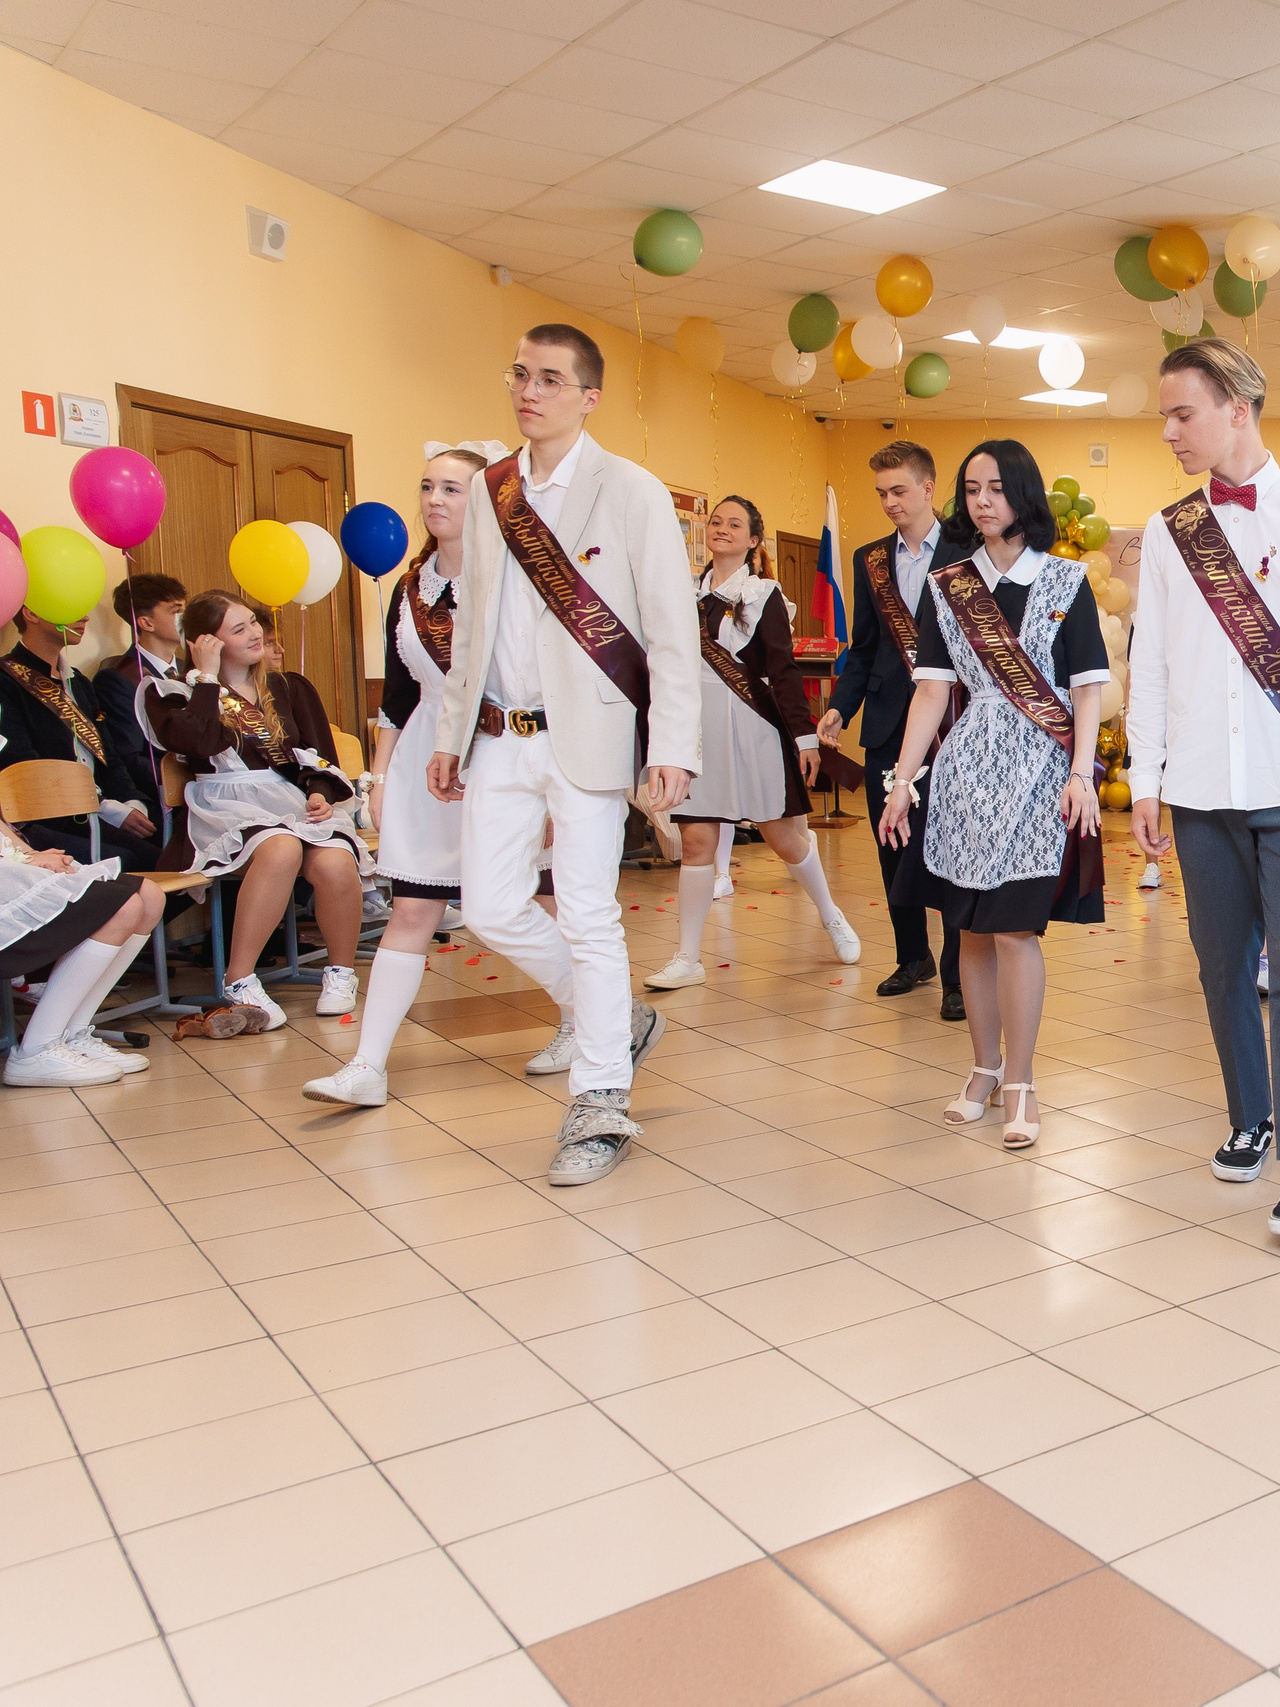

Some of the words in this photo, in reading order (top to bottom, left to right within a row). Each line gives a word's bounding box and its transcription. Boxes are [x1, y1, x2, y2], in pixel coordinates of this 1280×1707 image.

[505, 496, 581, 610] Выпускник
[569, 598, 625, 648] 2024
[873, 565, 917, 648] Выпускник
[1192, 529, 1271, 655] Выпускник
[1248, 596, 1274, 632] Максим
[966, 598, 1039, 702] Выпускница
[1219, 610, 1234, 633] Школа
[1248, 658, 1275, 697] Кронштадт
[35, 676, 103, 750] Выпускник
